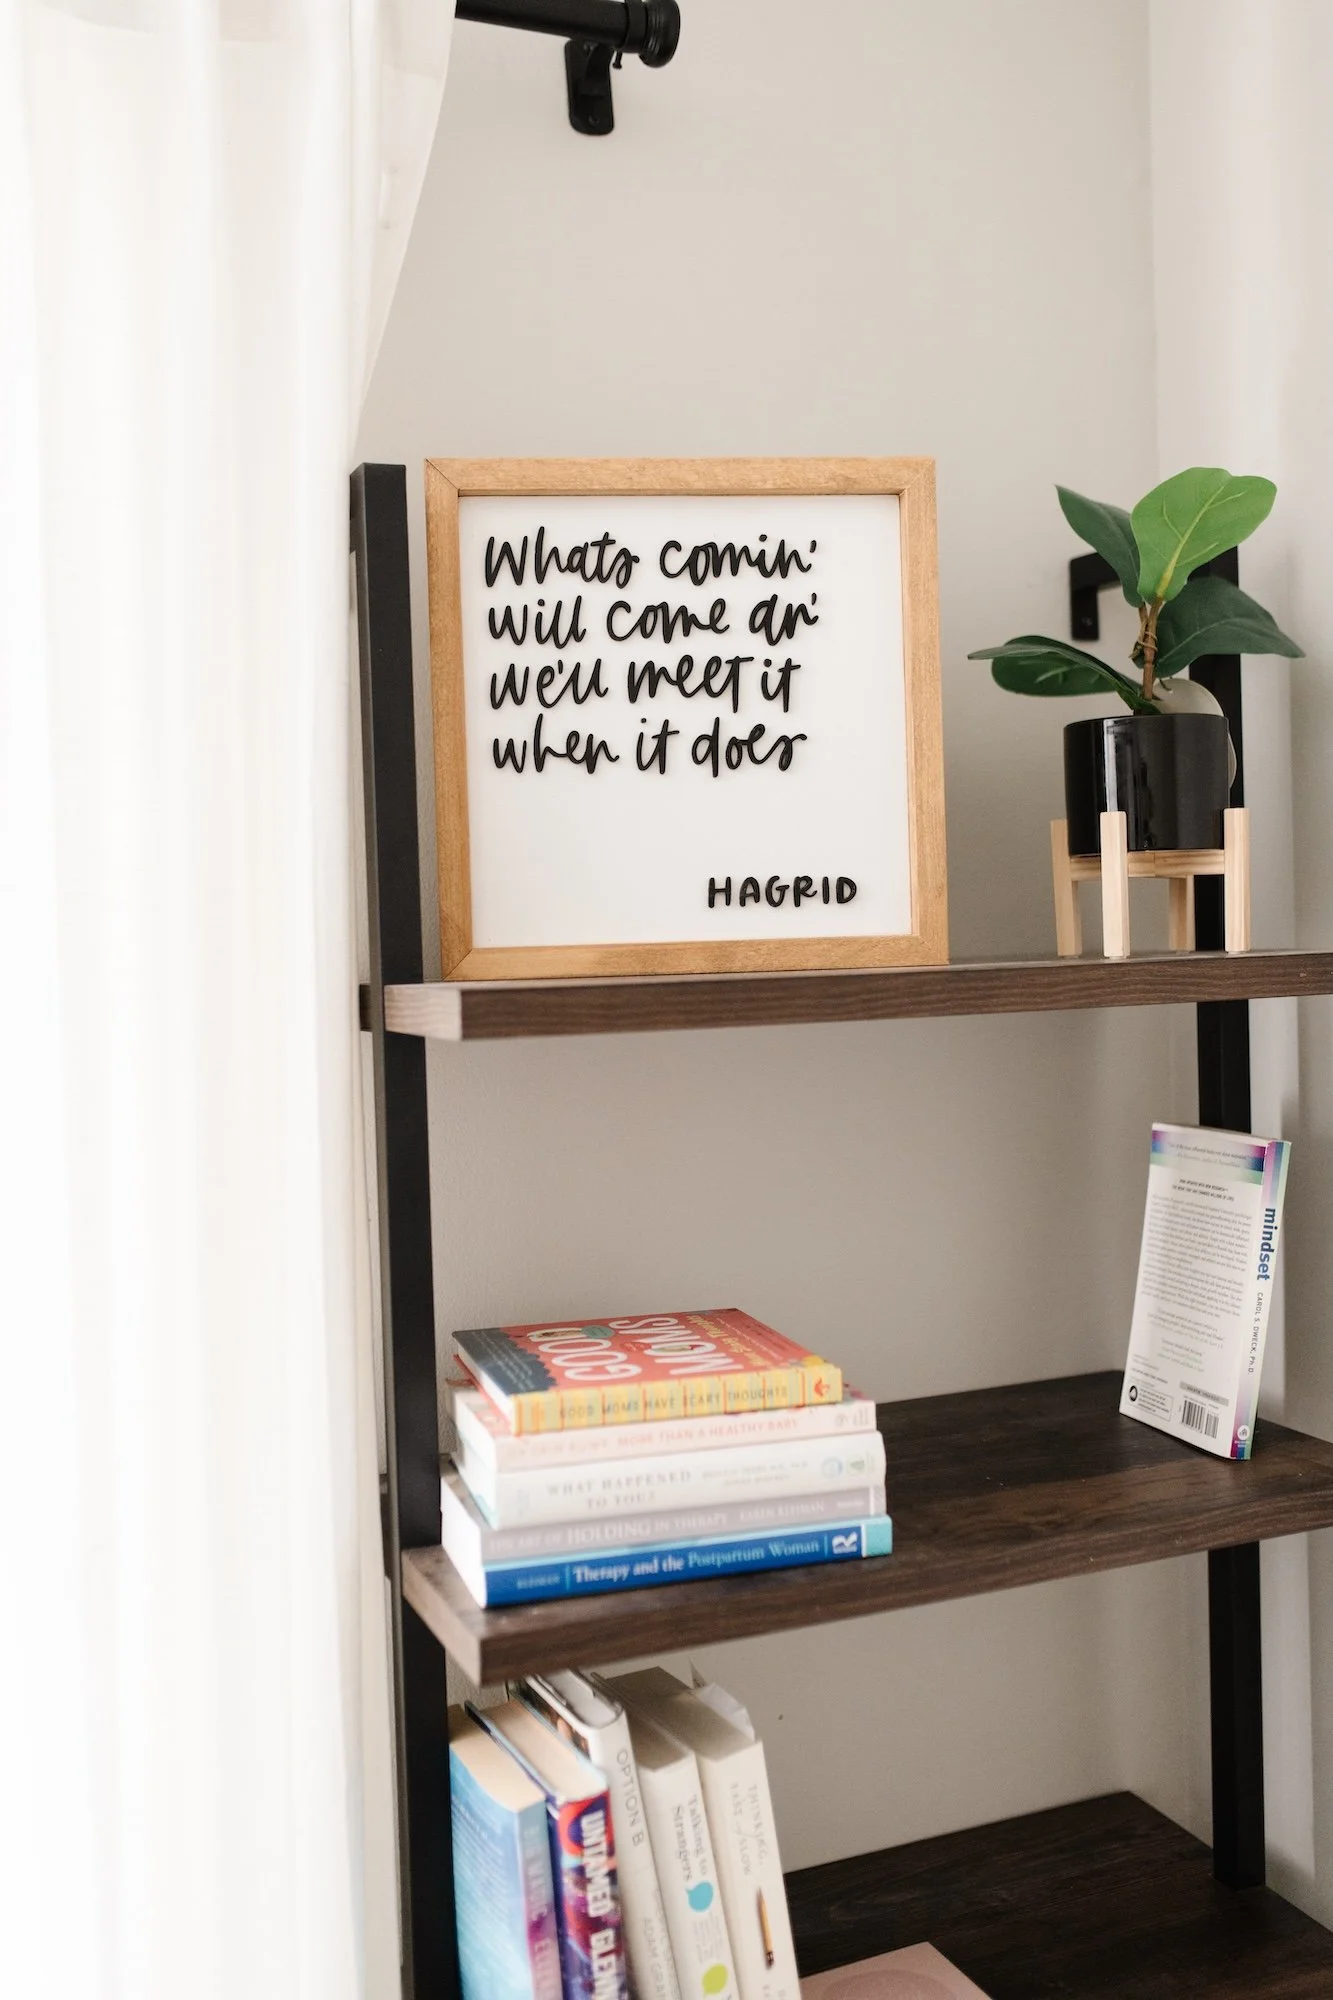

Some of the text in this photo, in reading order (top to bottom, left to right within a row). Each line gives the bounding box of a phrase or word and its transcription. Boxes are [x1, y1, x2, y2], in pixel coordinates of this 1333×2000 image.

[485, 526, 817, 588] Whats comin'
[488, 593, 819, 649] will come an'
[490, 654, 801, 713] we'll meet it
[493, 713, 807, 777] when it does
[708, 875, 857, 908] HAGRID
[1257, 1207, 1278, 1281] mindset
[1254, 1292, 1264, 1315] CAROL
[527, 1326, 642, 1381] GOOD
[607, 1316, 744, 1376] MOMS
[601, 1400, 640, 1415] MOMS
[644, 1396, 676, 1411] HAVE
[726, 1386, 788, 1402] THOUGHTS
[547, 1480, 594, 1496] WHAT
[602, 1470, 692, 1490] HAPPENED
[567, 1519, 652, 1545] HOLDING
[573, 1539, 820, 1584] Therapy and the Postpartum Woman
[616, 1749, 645, 1848] OPTION B
[687, 1793, 702, 1859] Talking
[580, 1810, 614, 1918] UNTAMED
[672, 1804, 694, 1882] Strangers
